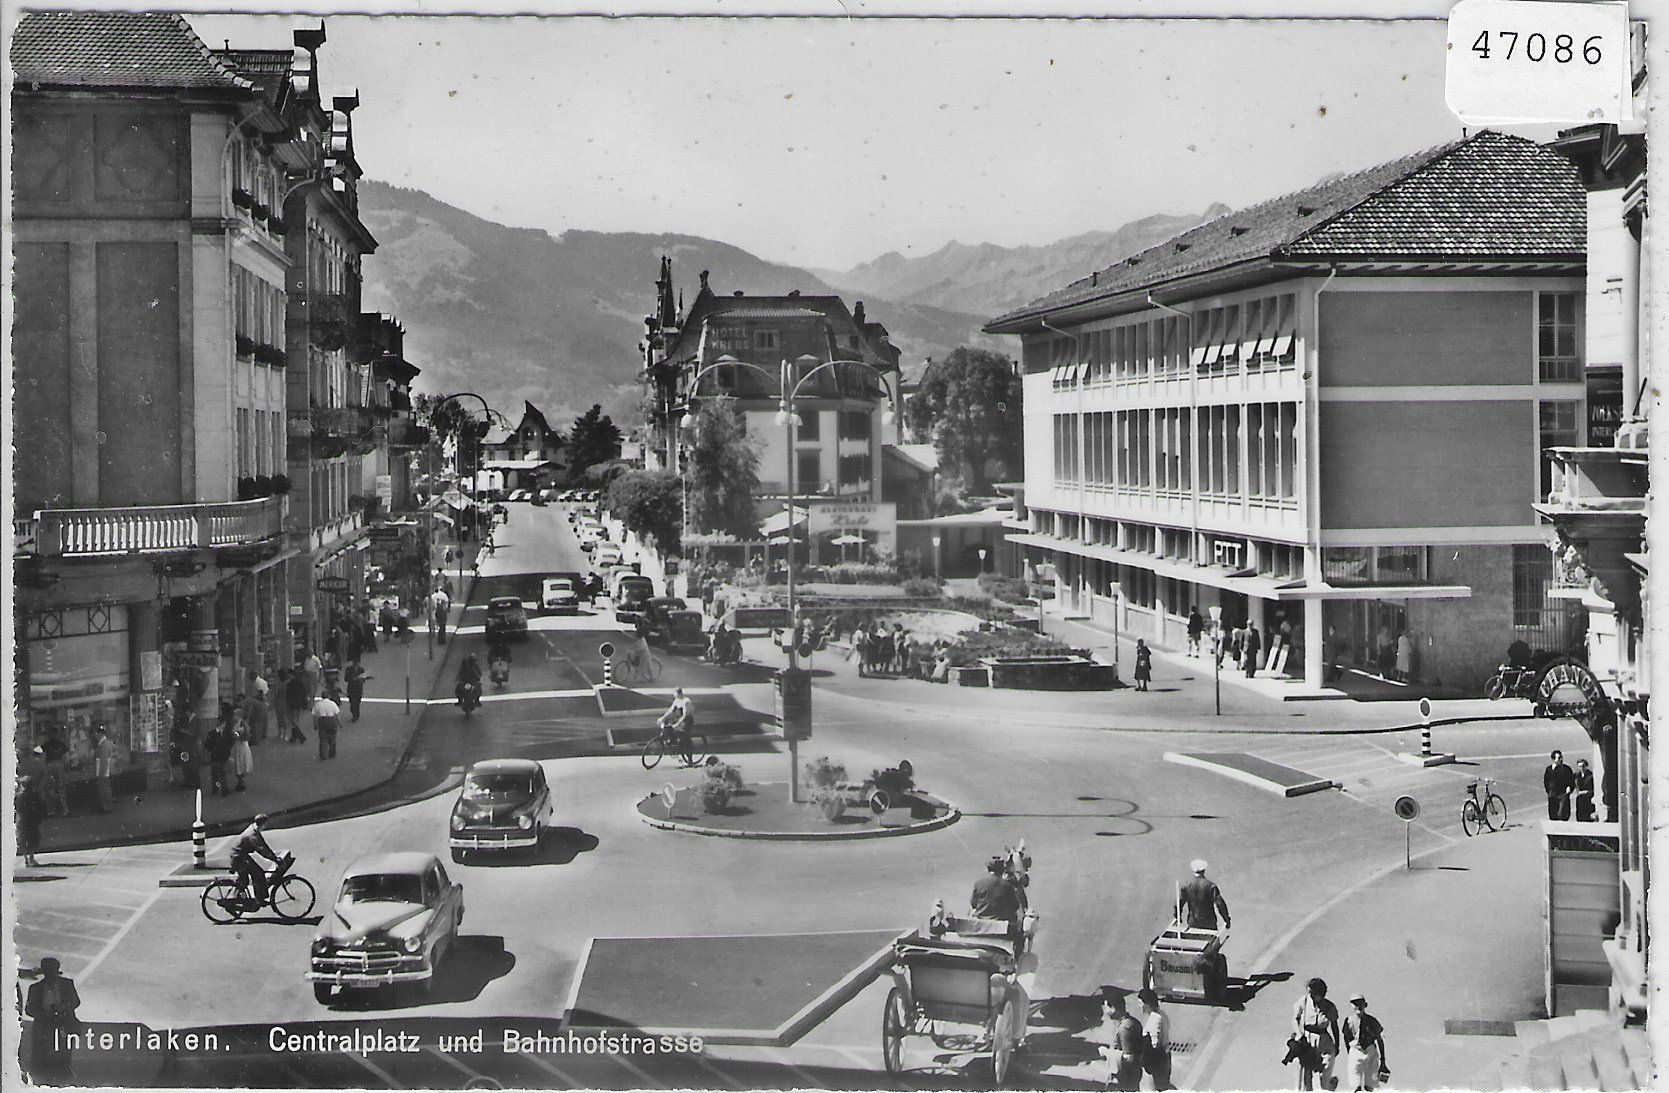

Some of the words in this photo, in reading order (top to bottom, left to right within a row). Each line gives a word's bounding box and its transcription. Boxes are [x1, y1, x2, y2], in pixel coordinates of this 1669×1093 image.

[1471, 30, 1603, 65] 47086
[711, 327, 749, 338] HOTEL
[1214, 540, 1242, 568] PTT
[318, 579, 348, 589] MERKUR
[1540, 664, 1600, 705] CHANGE
